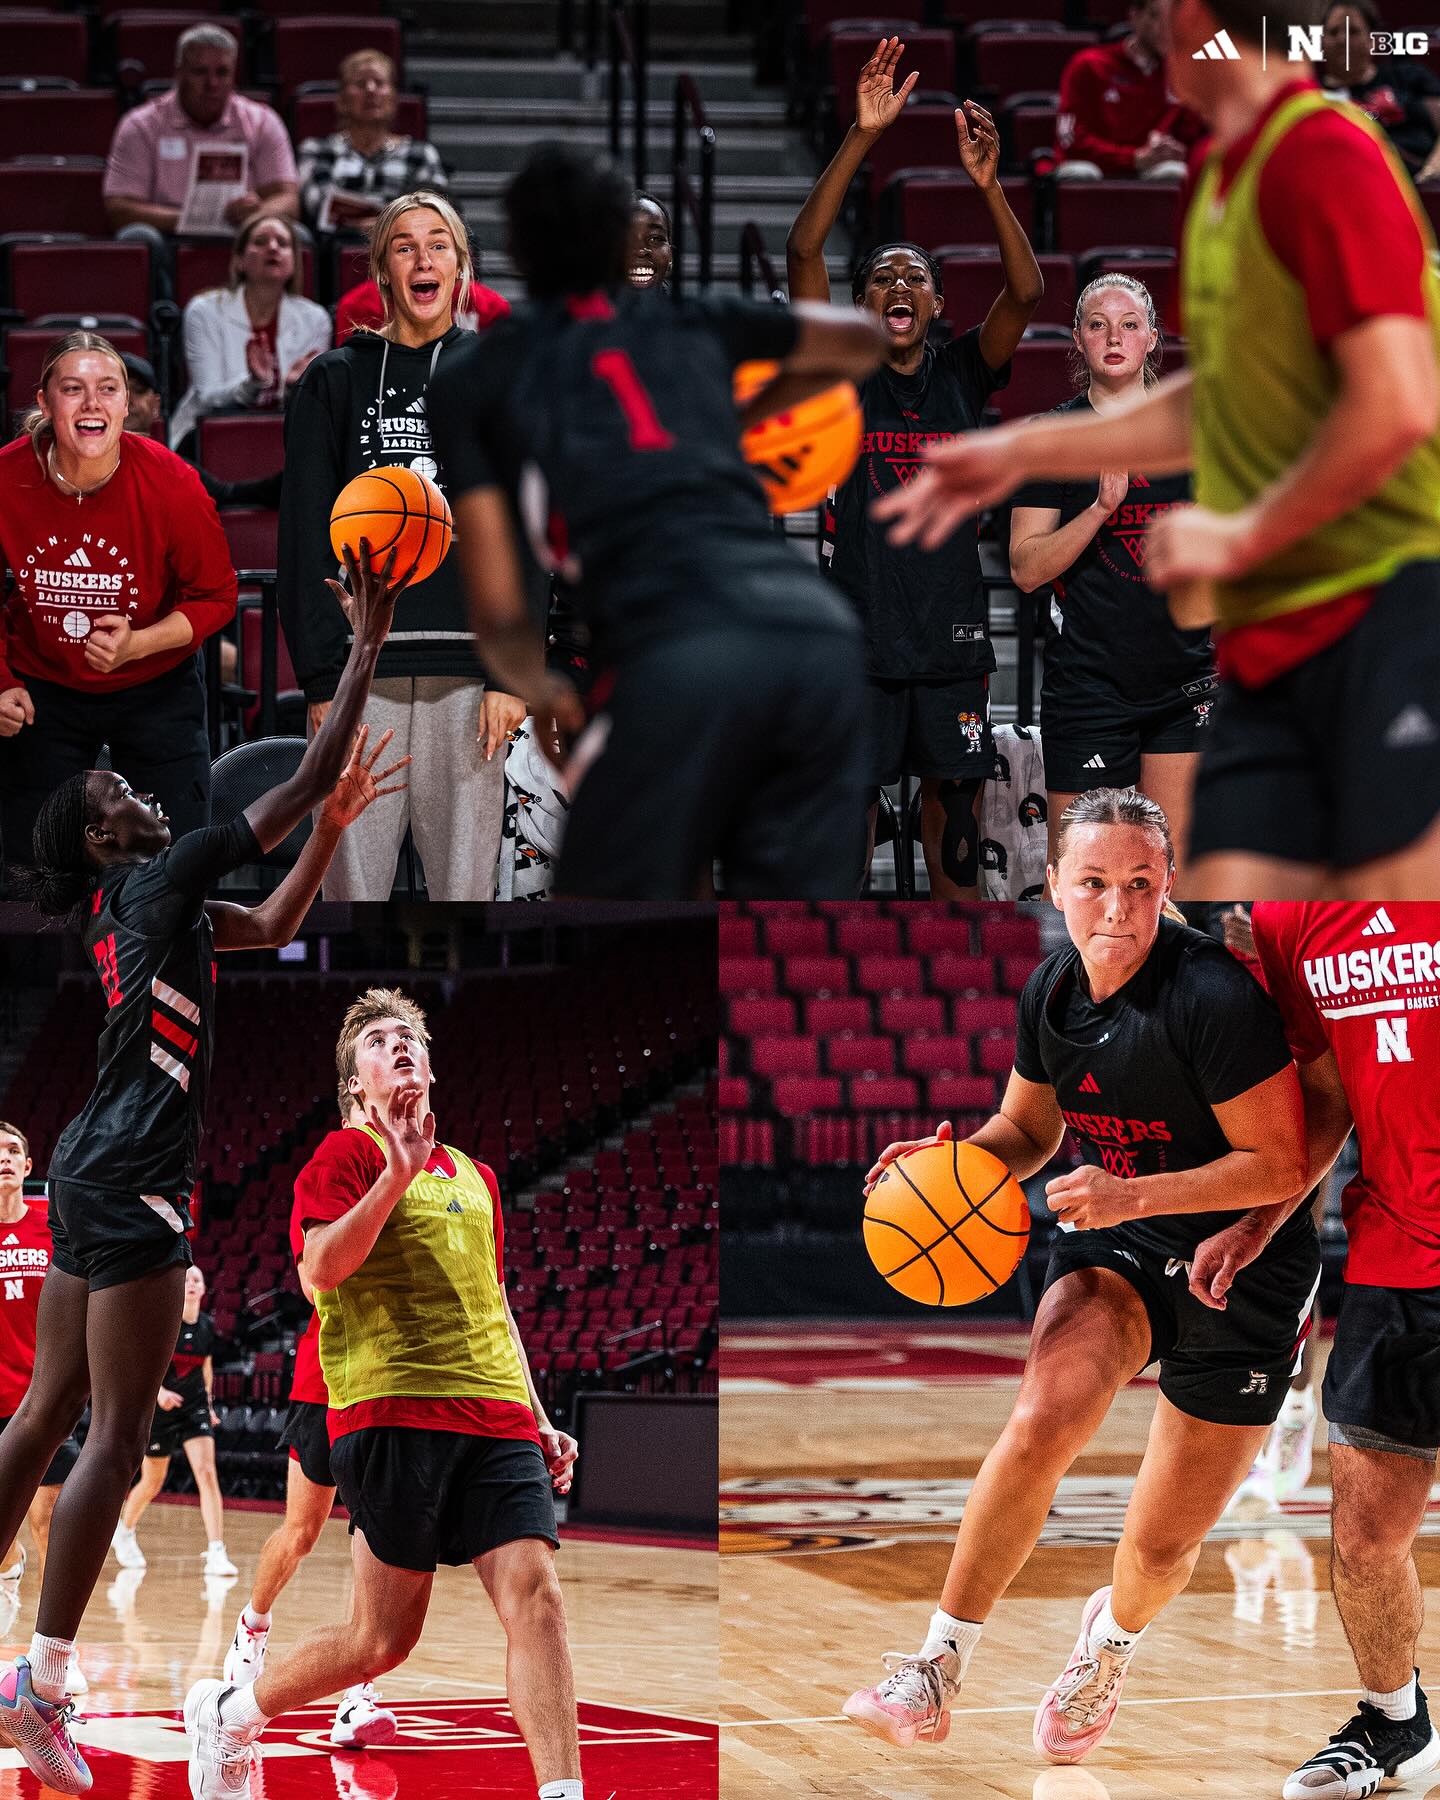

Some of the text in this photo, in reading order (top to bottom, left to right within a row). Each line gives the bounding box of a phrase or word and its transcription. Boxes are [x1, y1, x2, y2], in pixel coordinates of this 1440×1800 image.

[592, 349, 677, 451] 1
[377, 417, 431, 434] HUSK
[382, 438, 432, 449] BASKET
[34, 568, 123, 590] HUSKERS
[38, 591, 117, 605] BASKETBALL
[1385, 988, 1397, 997] OF
[1406, 985, 1437, 995] NEBRA
[1407, 995, 1440, 1010] BASKET
[1375, 1017, 1412, 1063] N
[1063, 1109, 1173, 1144] USKERS
[0, 1248, 48, 1267] SKERS
[4, 1279, 24, 1300] N
